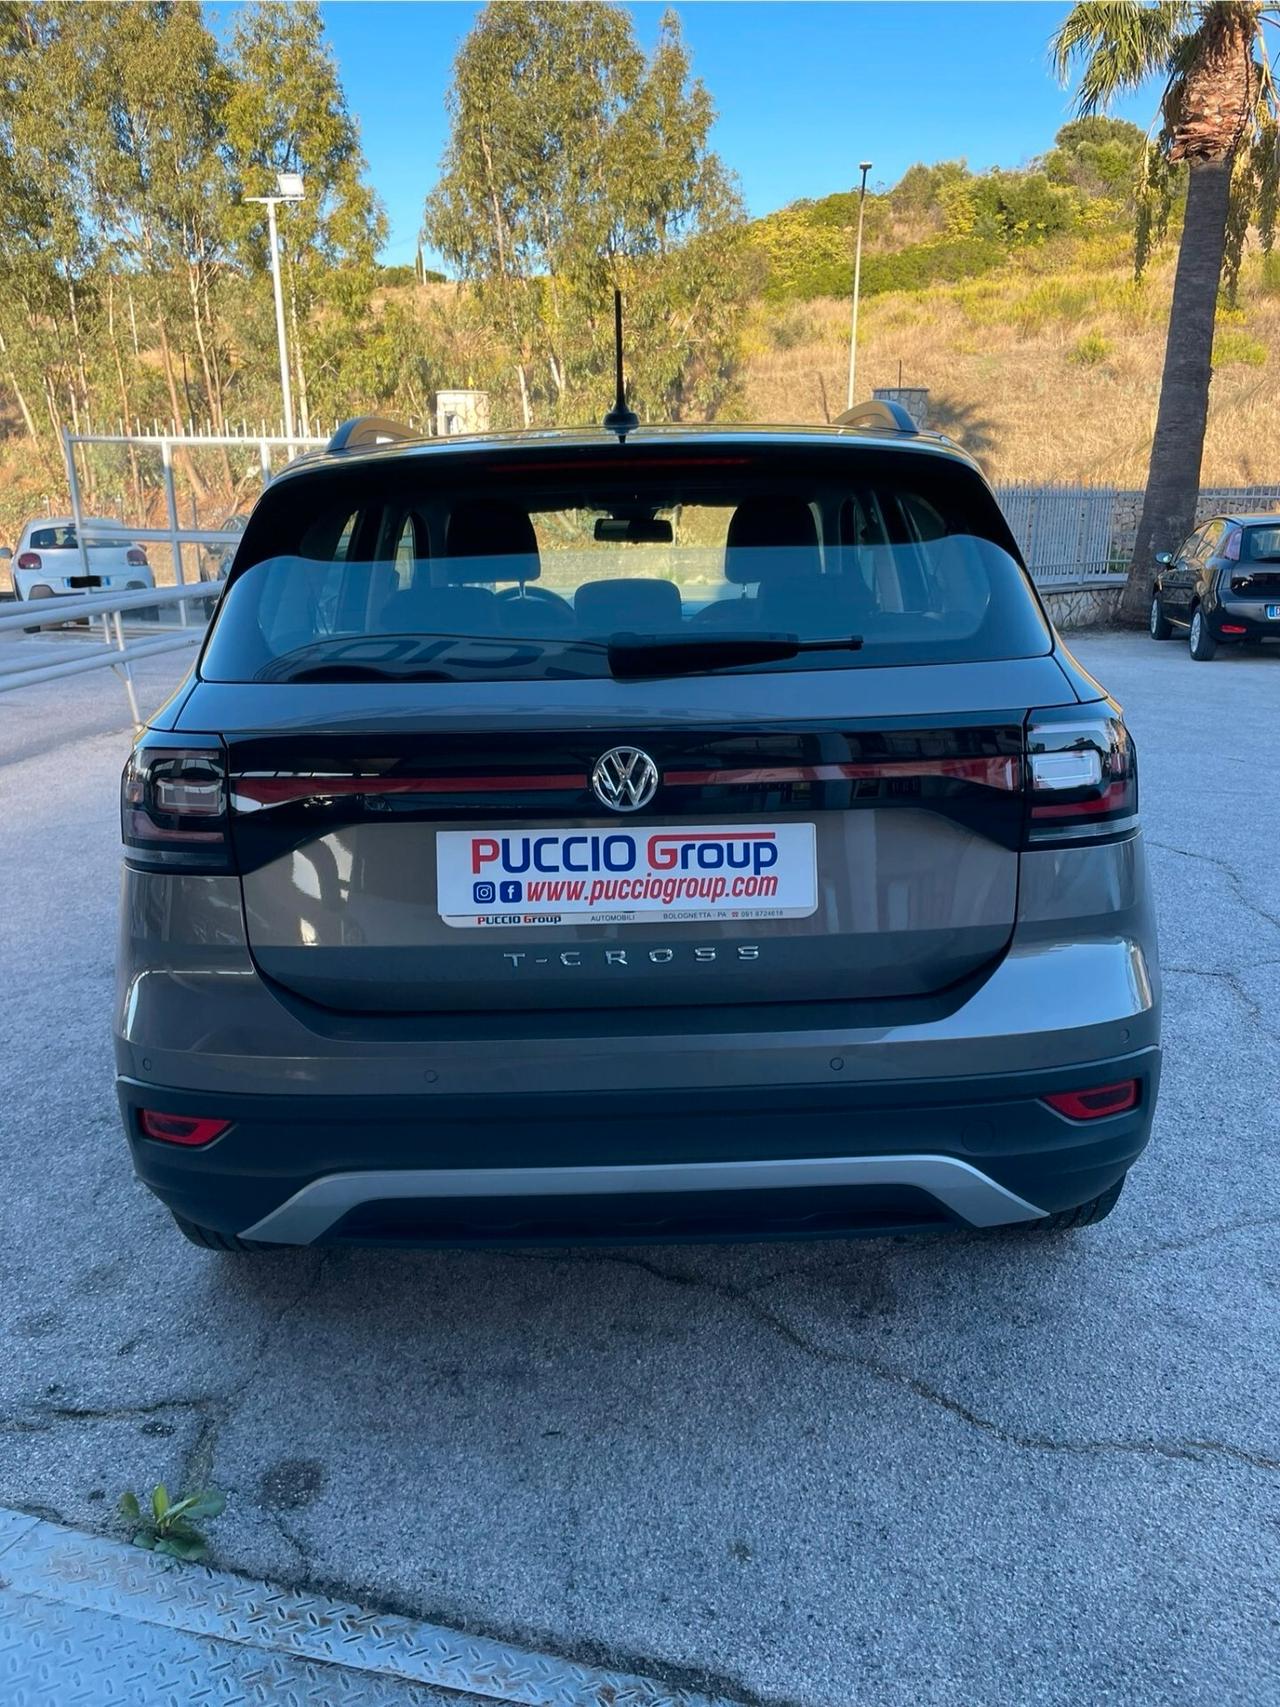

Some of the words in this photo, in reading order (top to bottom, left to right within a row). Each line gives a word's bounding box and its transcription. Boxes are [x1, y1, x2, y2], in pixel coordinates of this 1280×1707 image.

[472, 835, 636, 874] PUCCIO
[647, 832, 778, 875] Group
[527, 872, 778, 905] www.pucciogroup.com
[477, 915, 521, 925] PUCCIO
[524, 912, 562, 924] Group
[590, 914, 636, 922] AUTOMOBILI
[663, 911, 712, 920] BOLOGNETTA
[503, 945, 760, 967] T-CROSS
